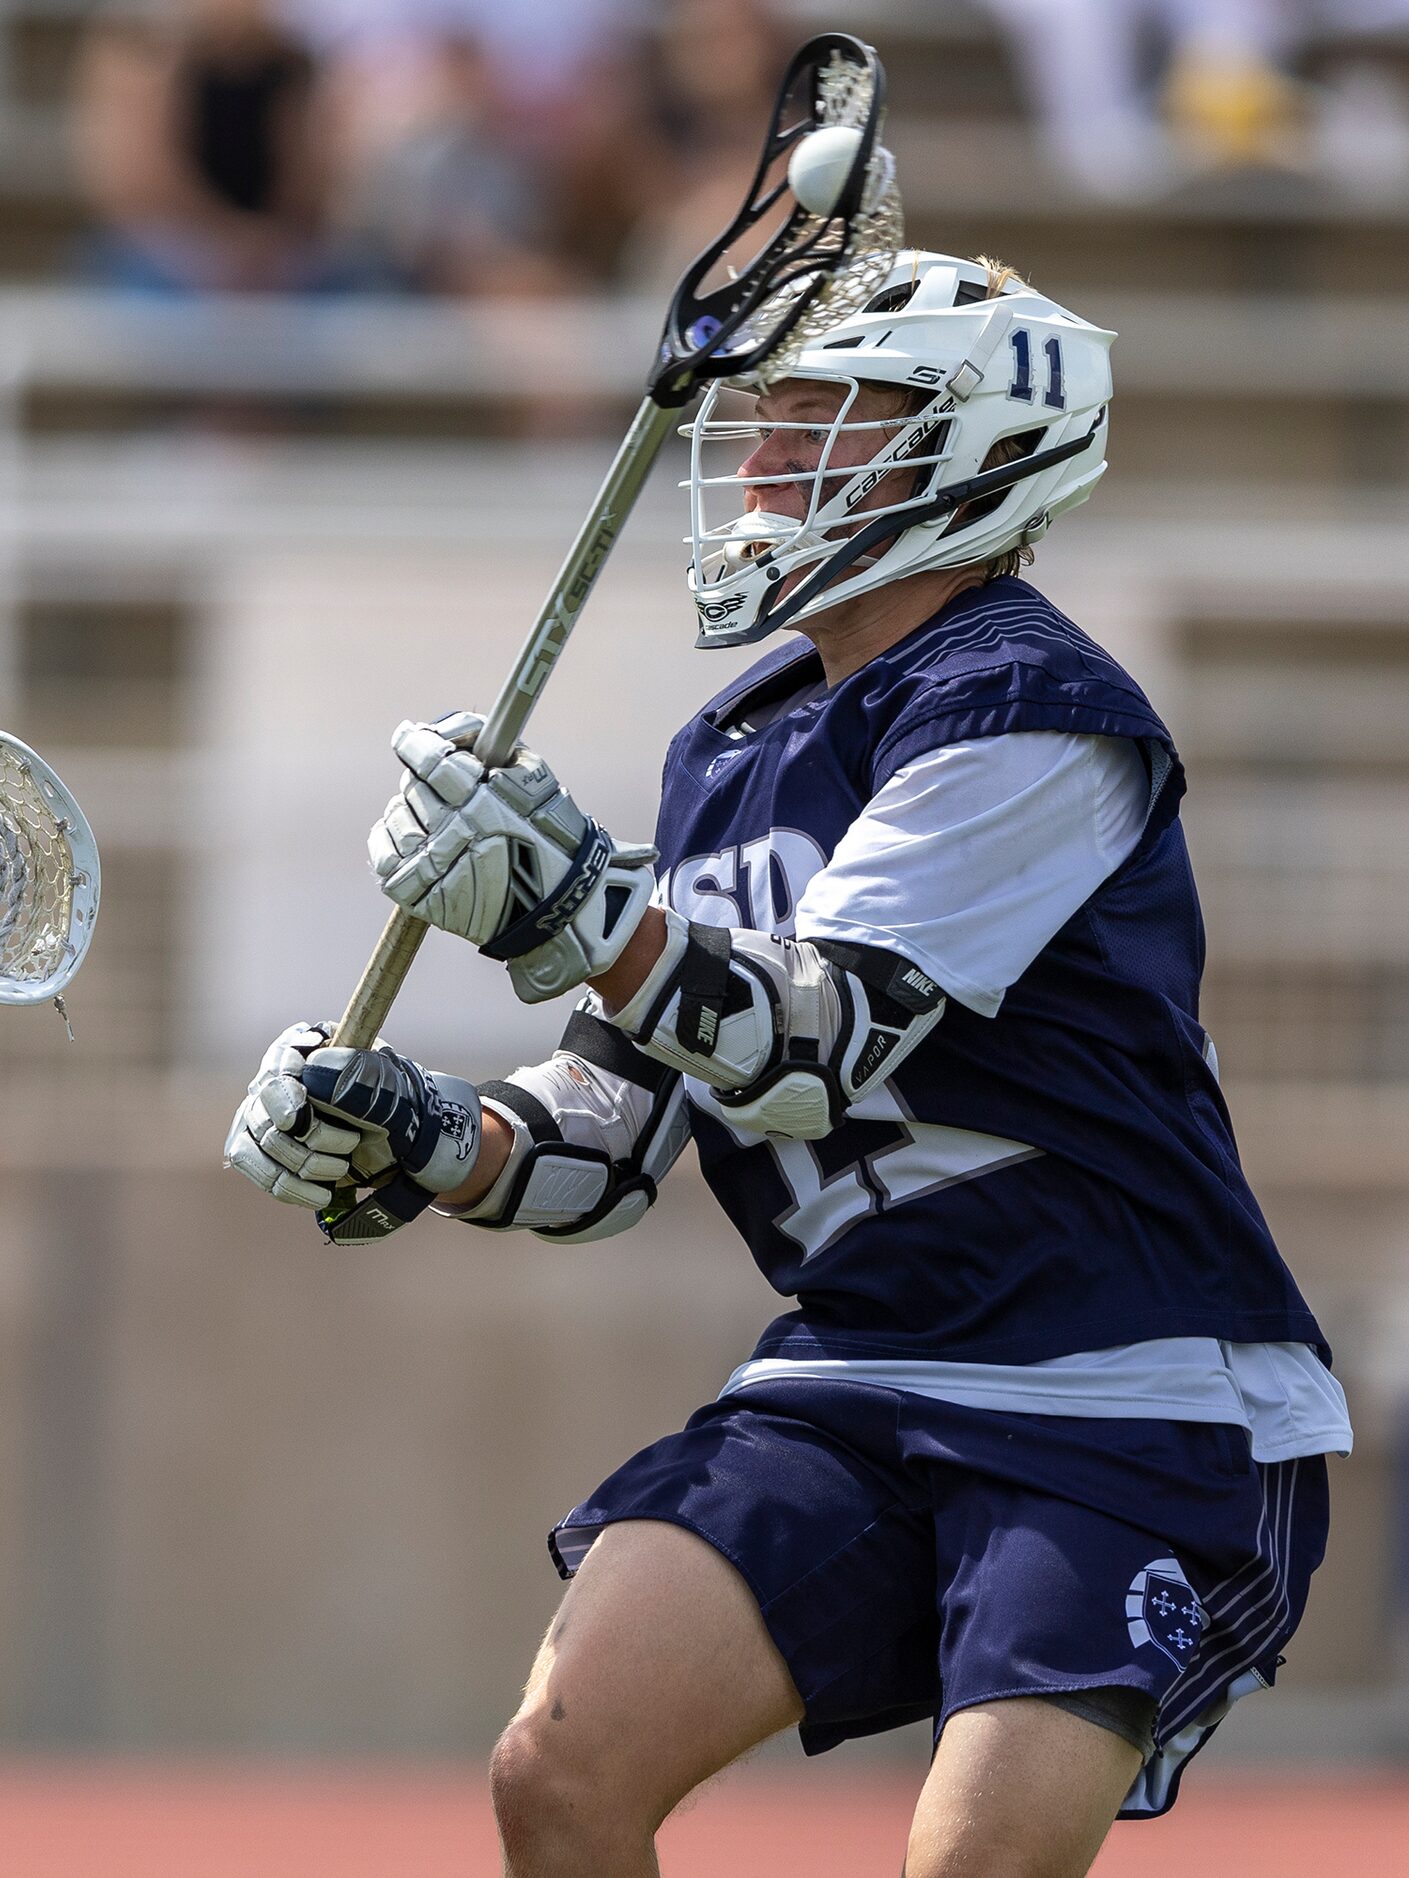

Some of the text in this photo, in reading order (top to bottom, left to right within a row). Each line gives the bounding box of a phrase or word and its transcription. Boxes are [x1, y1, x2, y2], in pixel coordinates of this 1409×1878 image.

[1006, 326, 1067, 413] 11
[516, 591, 579, 698] STX
[902, 968, 938, 997] NIKE
[697, 1005, 718, 1046] NIKE
[855, 1034, 888, 1084] VAPOR
